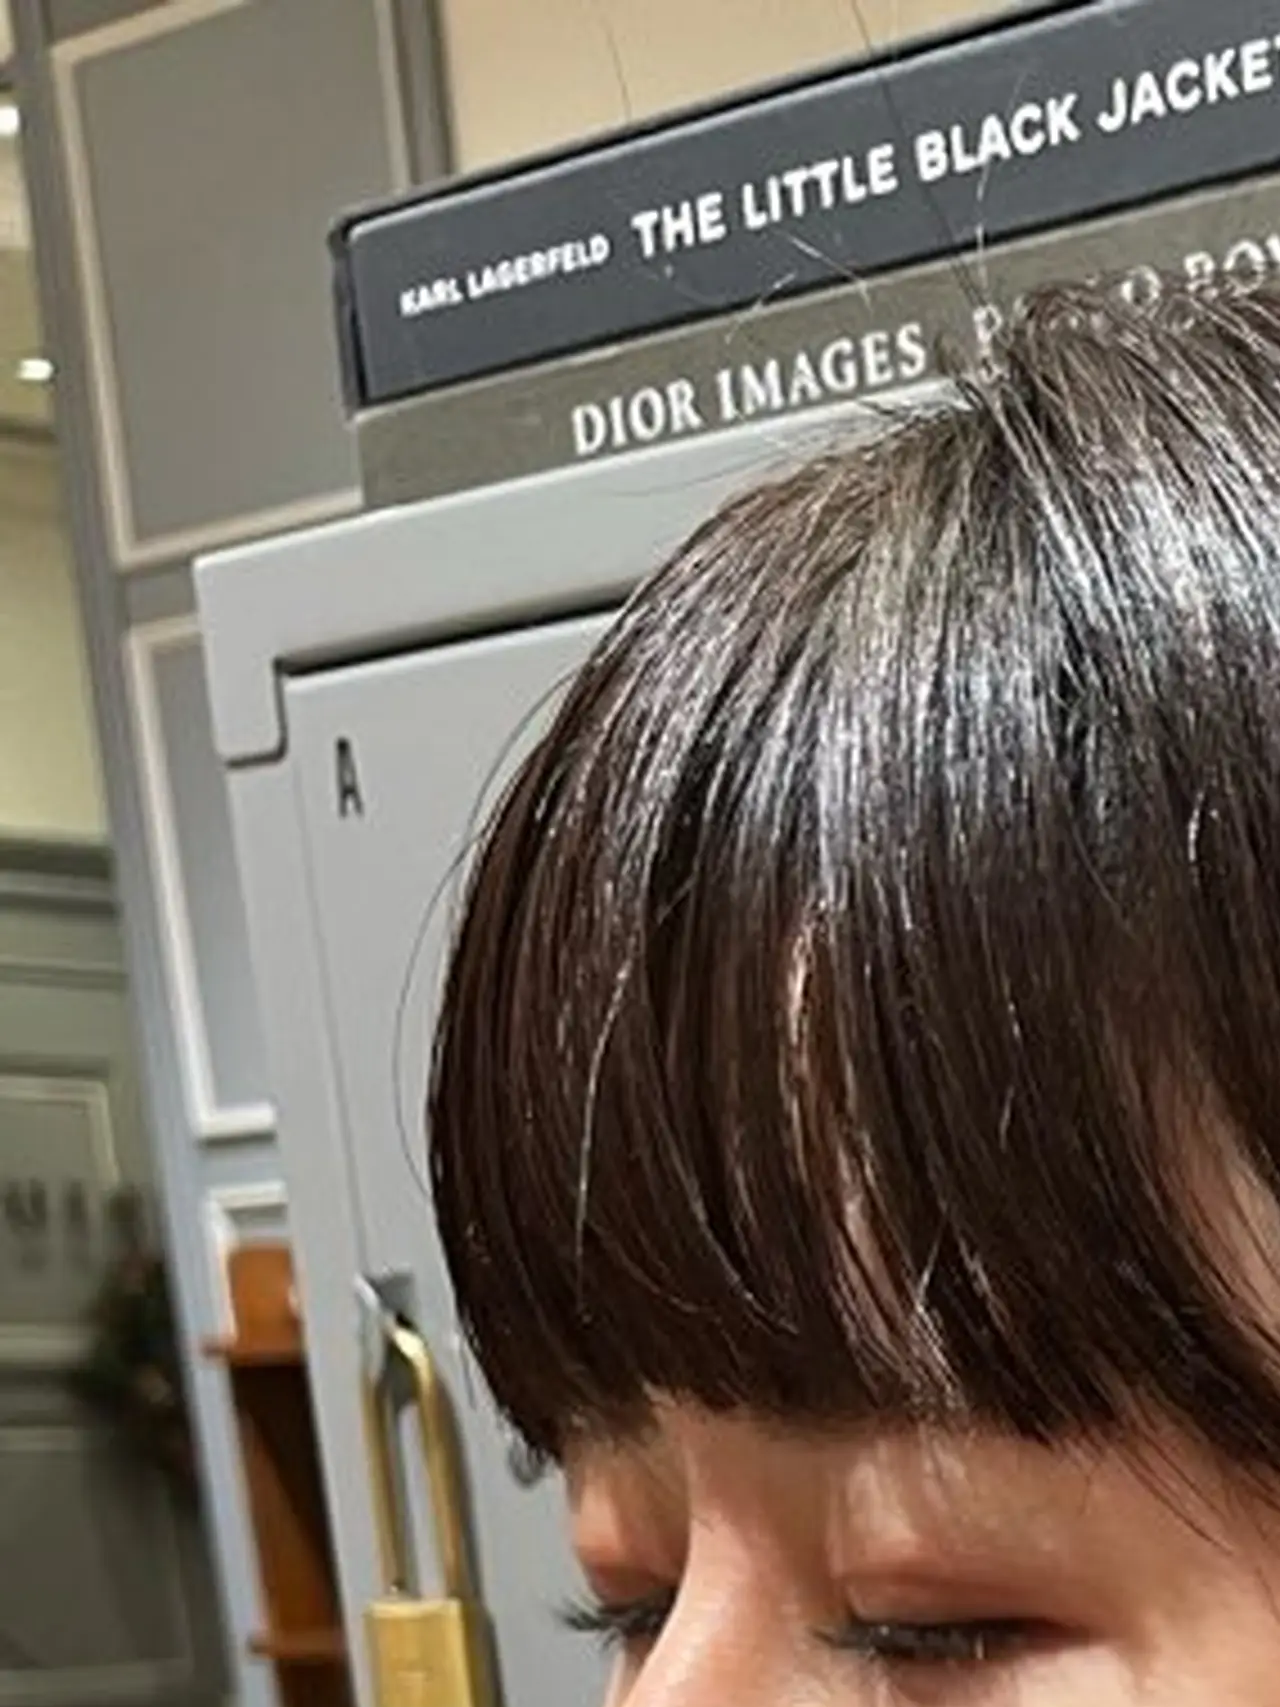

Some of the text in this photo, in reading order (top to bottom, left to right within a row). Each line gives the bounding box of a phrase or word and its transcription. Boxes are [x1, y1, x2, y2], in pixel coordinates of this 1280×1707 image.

[400, 276, 464, 317] KARL
[466, 233, 611, 300] LAGERFELD
[631, 192, 728, 259] THE
[741, 143, 898, 231] LITTLE
[914, 92, 1082, 183] BLACK
[570, 377, 702, 457] DIOR
[715, 321, 928, 421] IMAGES
[336, 736, 365, 820] A
